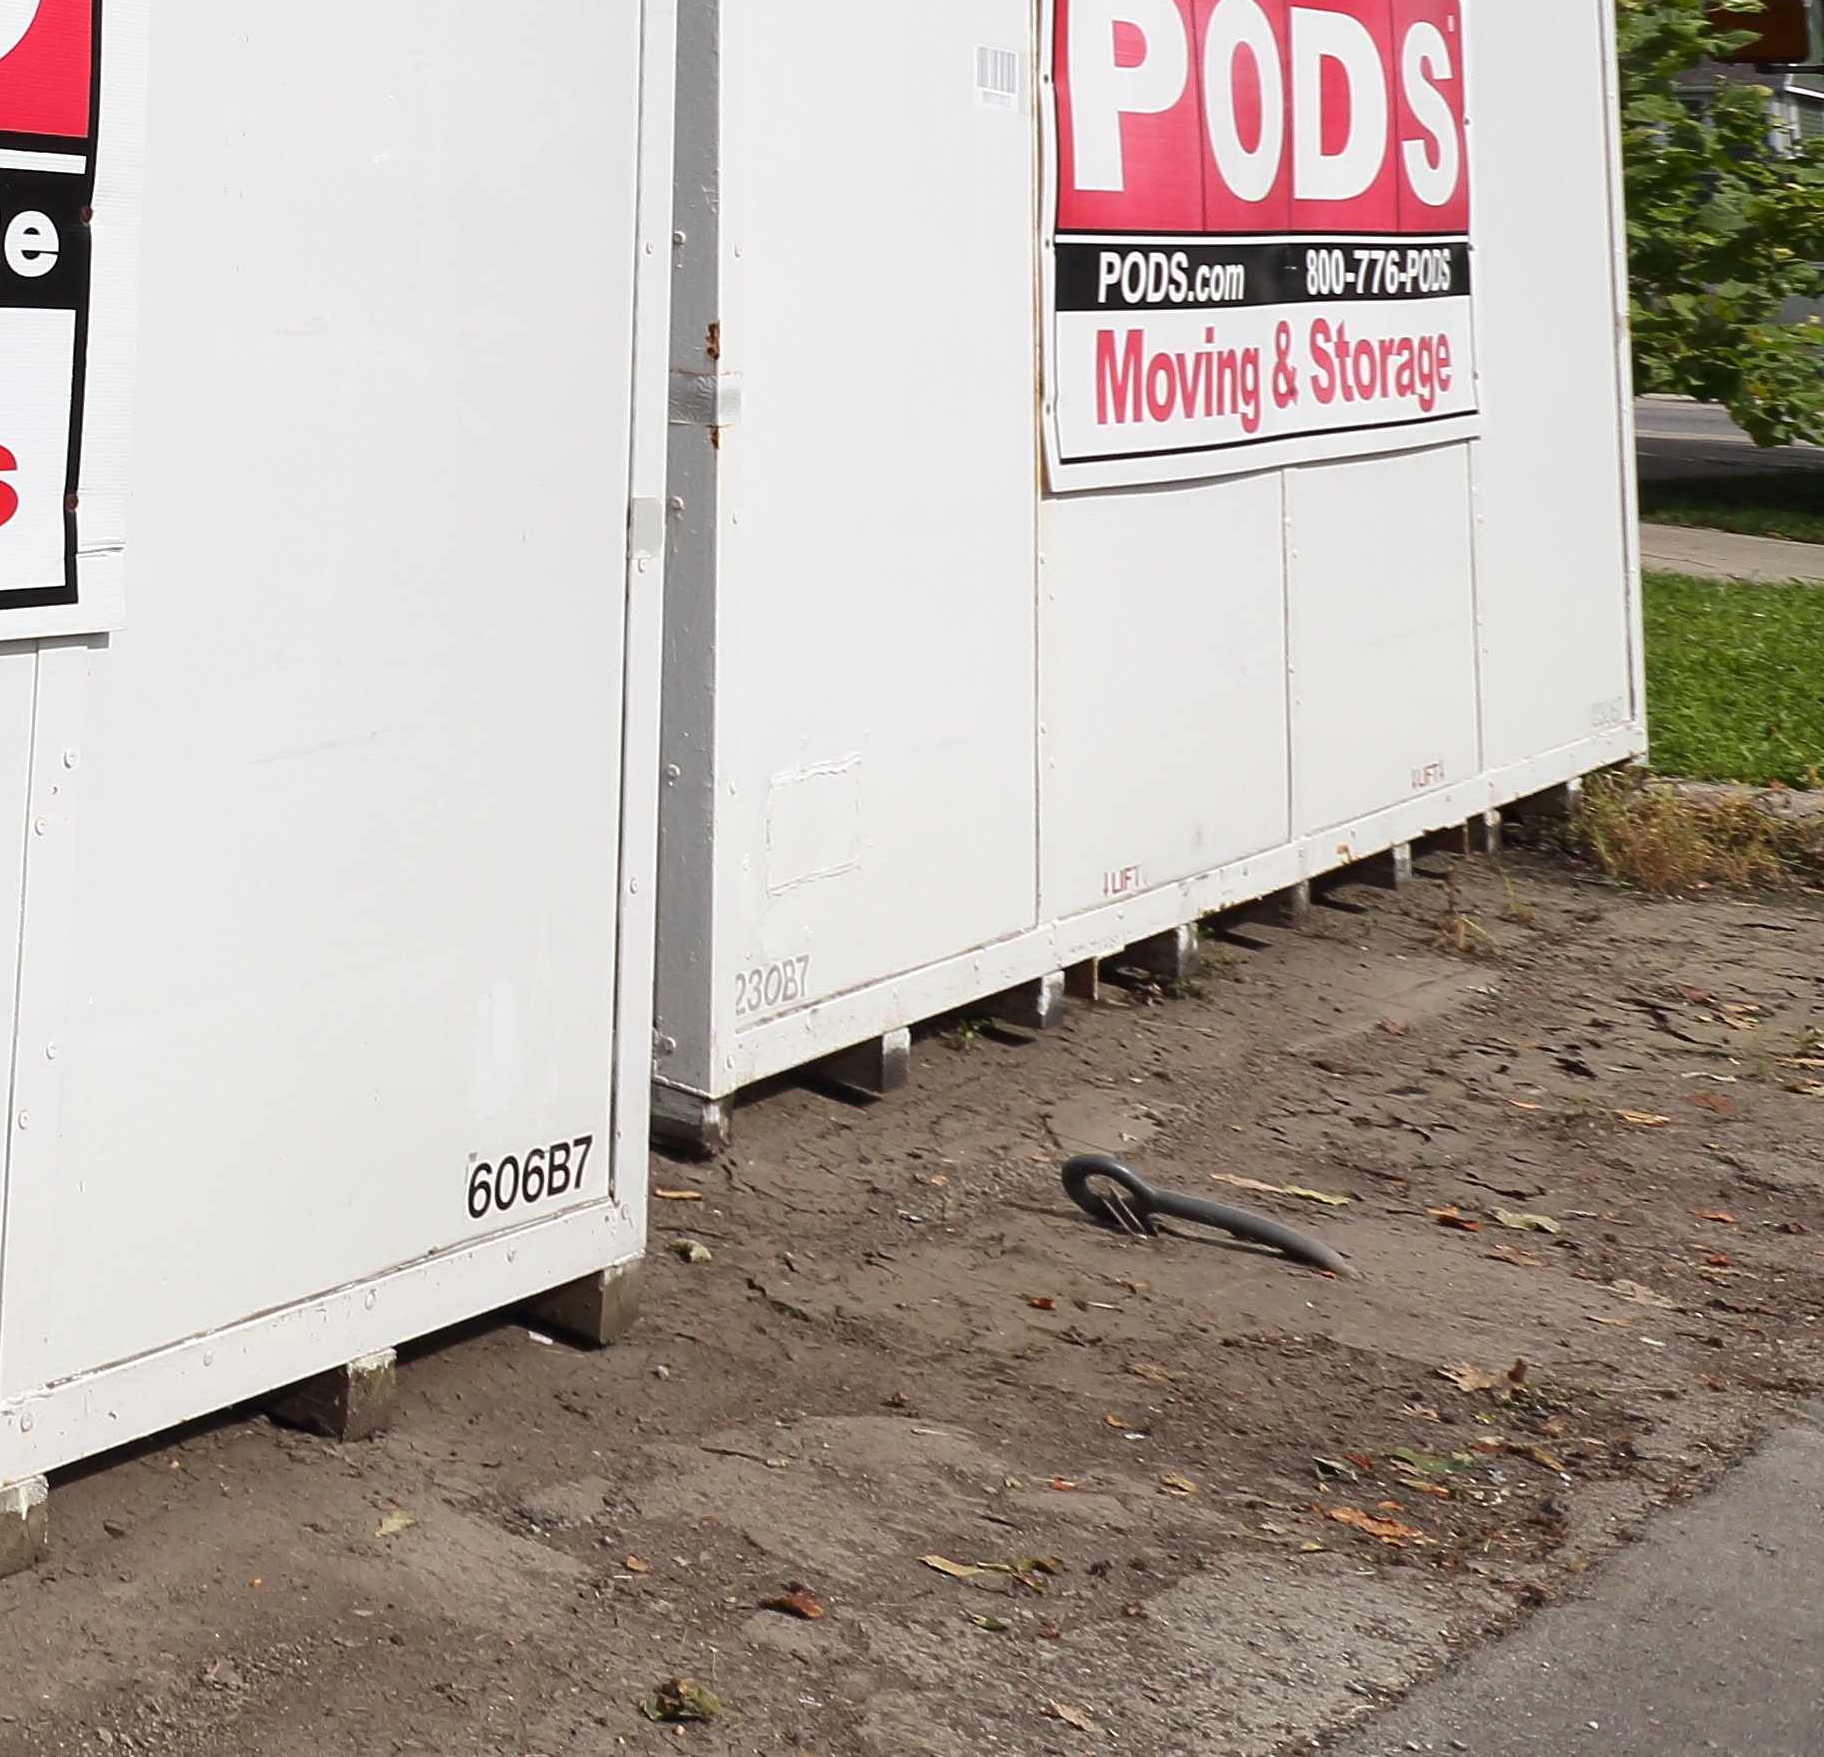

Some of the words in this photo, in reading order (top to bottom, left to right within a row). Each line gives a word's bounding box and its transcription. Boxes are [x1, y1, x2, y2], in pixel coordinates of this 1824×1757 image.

[1097, 252, 1244, 303] PODS.com
[1305, 249, 1451, 295] 800-776-PODS
[1096, 326, 1260, 432] Moving
[1273, 321, 1299, 409] &
[1310, 318, 1451, 411] Storage
[1111, 865, 1141, 893] LIFT
[735, 954, 811, 1015] 230B7
[467, 1136, 593, 1219] 606B7
